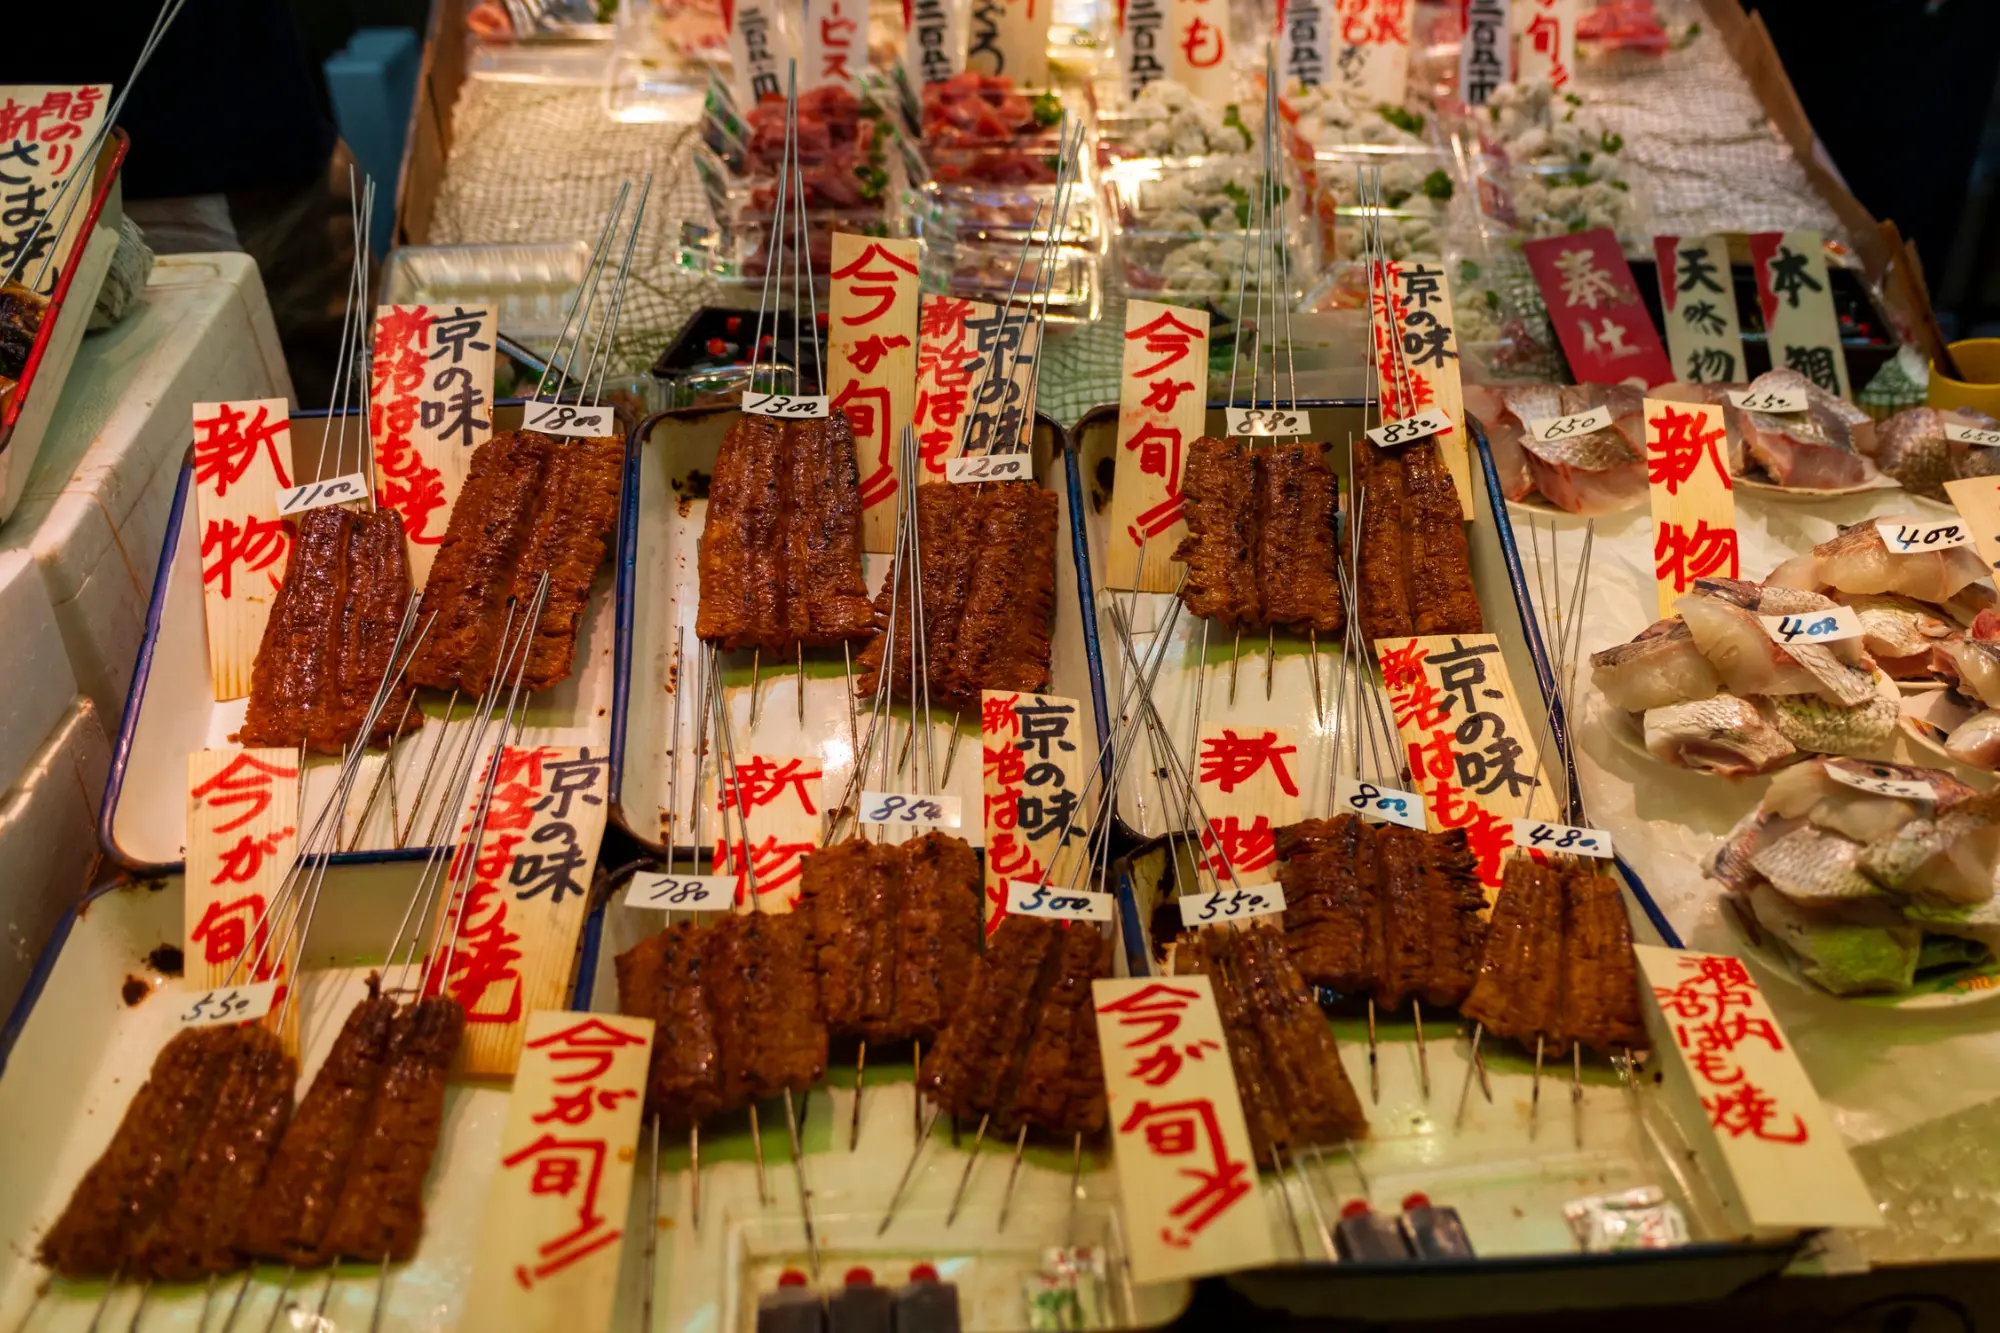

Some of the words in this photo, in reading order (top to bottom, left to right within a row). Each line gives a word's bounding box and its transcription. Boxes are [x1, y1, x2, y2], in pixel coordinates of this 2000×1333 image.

[39, 85, 104, 176] 脂のり
[420, 306, 492, 447] 京の味
[1398, 263, 1459, 369] 京の味
[1553, 249, 1648, 390] 奉仕
[192, 403, 297, 601] 新物
[1544, 417, 1596, 441] 650
[1646, 405, 1740, 594] 新物
[1014, 696, 1088, 847] 京の味
[1423, 637, 1542, 798] 京の味
[508, 745, 610, 904] 京の味
[712, 755, 823, 912] 新物
[1199, 729, 1300, 881] 新物
[650, 878, 710, 903] 780
